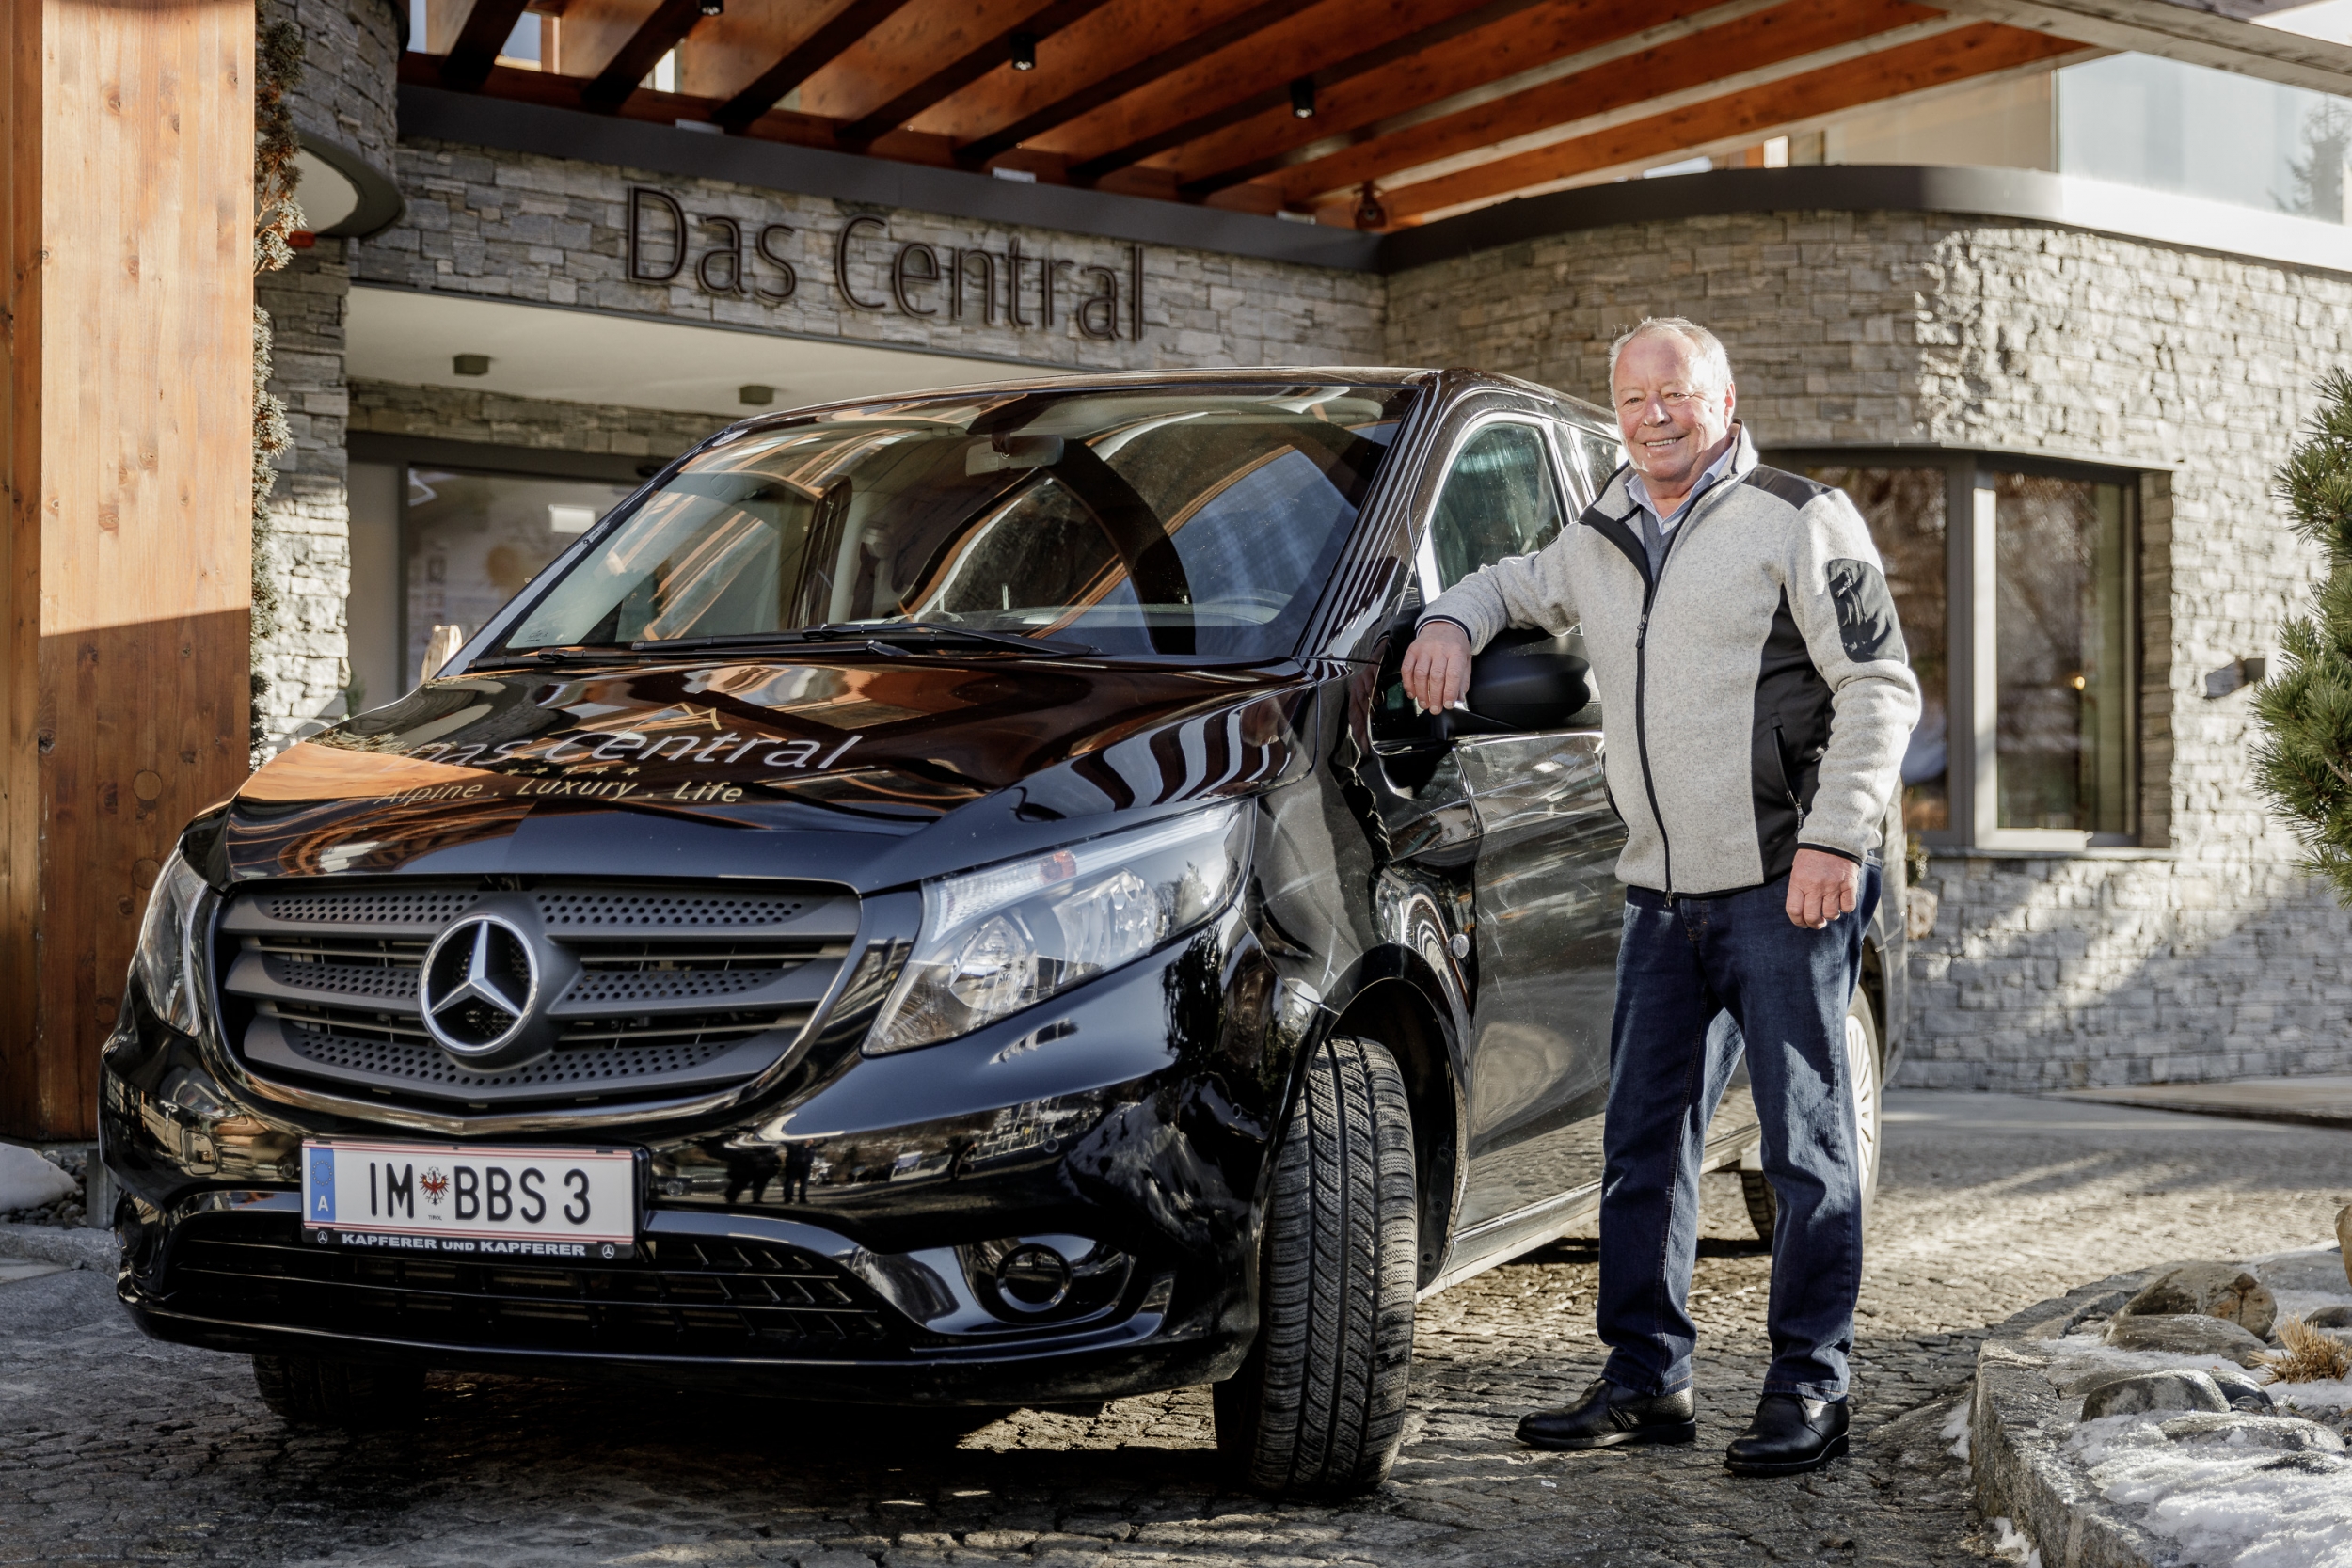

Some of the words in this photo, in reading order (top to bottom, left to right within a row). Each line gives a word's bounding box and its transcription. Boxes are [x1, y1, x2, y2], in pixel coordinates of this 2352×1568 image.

[627, 184, 798, 303] Das
[835, 213, 1145, 342] Central
[377, 738, 533, 774] Das
[544, 731, 863, 769] Central
[373, 783, 484, 807] Alpine
[516, 778, 639, 801] Luxury
[673, 780, 743, 803] Life
[317, 1195, 329, 1212] A
[370, 1162, 415, 1219] IM
[453, 1164, 547, 1224] BBS
[564, 1168, 591, 1225] 3
[342, 1233, 437, 1250] KAPFERER
[442, 1241, 475, 1252] UND
[480, 1241, 585, 1257] KAPFERER
